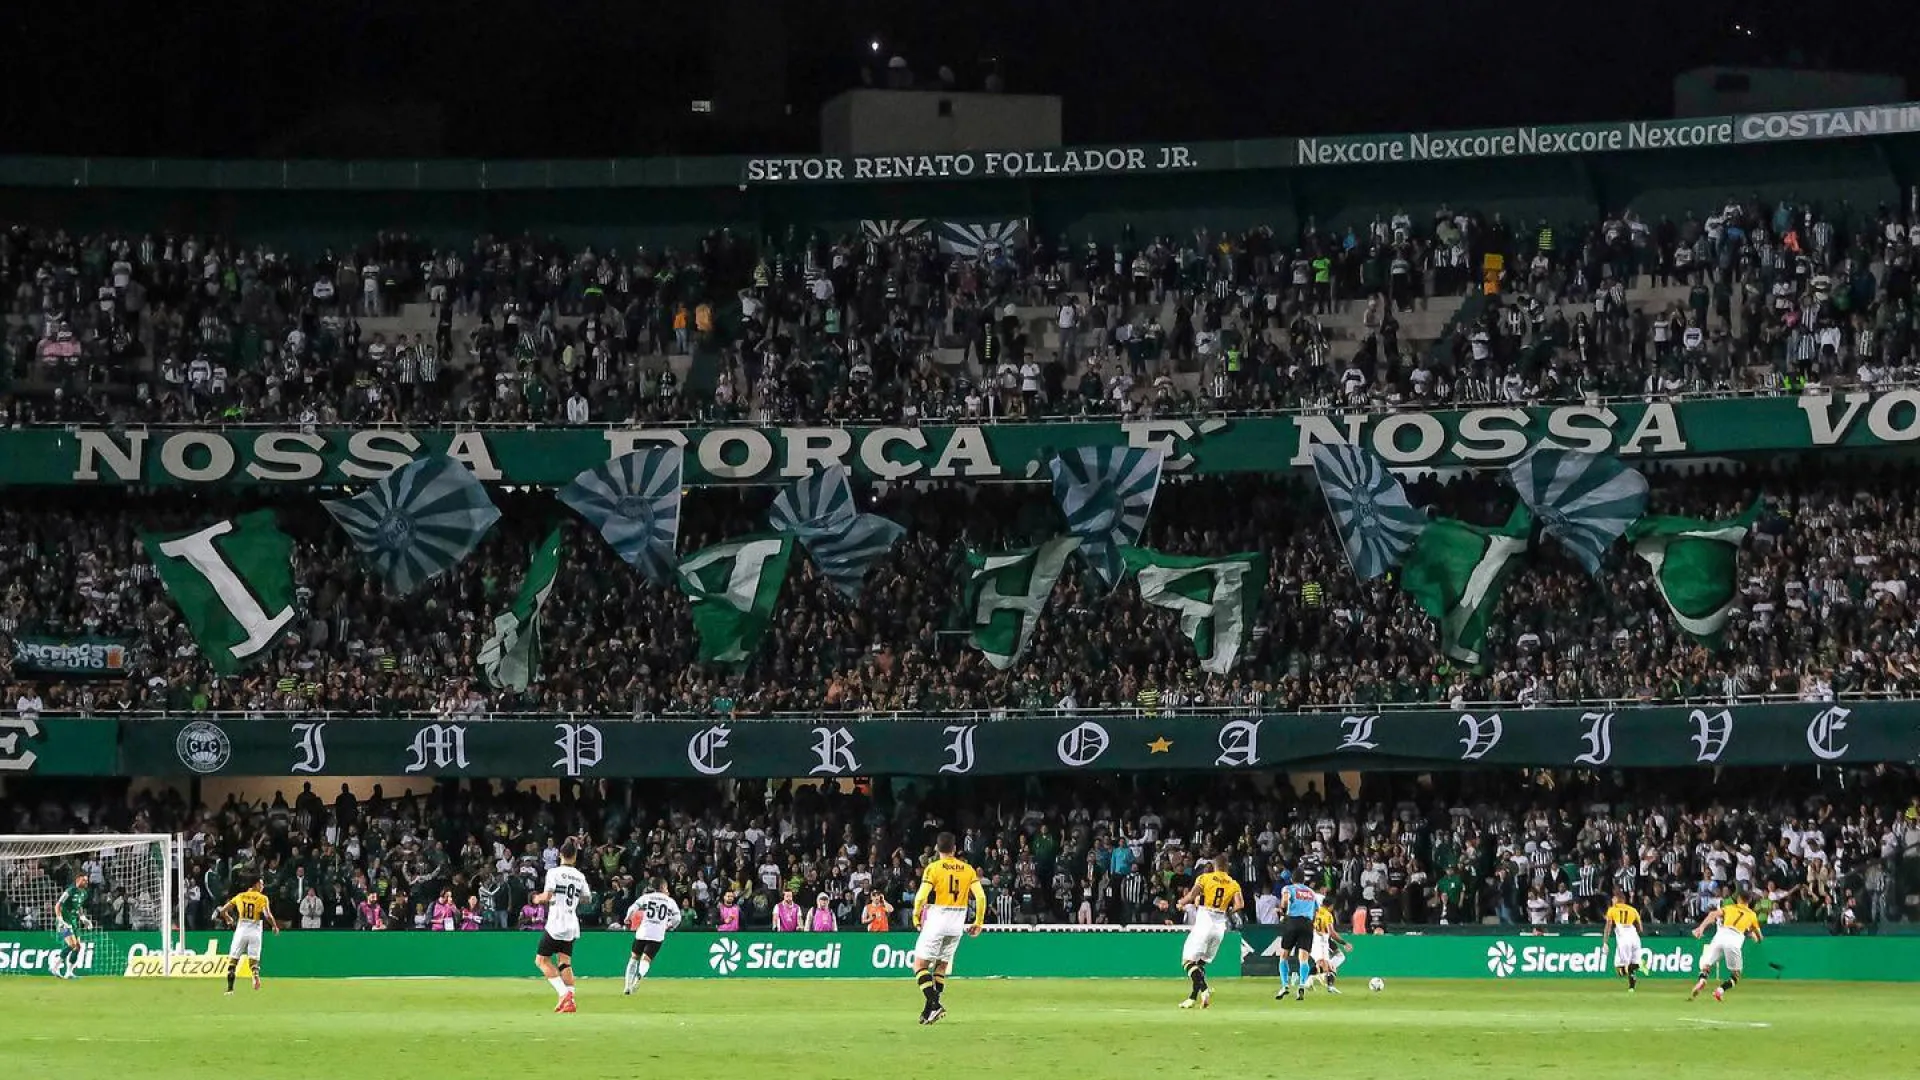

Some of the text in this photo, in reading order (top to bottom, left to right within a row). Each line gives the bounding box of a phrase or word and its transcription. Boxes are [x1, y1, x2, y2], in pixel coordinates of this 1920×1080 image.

[1299, 122, 1732, 164] Nexcore Nexcore Nexcore Nexcore
[748, 147, 1198, 181] SETOR RENATO FOLLADOR JR.
[72, 430, 503, 482] NOSSA
[1290, 402, 1687, 467] NOSSA
[565, 883, 576, 907] 9
[948, 873, 960, 903] 4
[1212, 887, 1225, 909] 8
[242, 901, 255, 920] 10
[646, 900, 669, 921] 50
[1618, 909, 1629, 924] 11
[1732, 910, 1745, 927] 7
[746, 943, 841, 969] Sicredi
[1521, 946, 1607, 972] Sicredi
